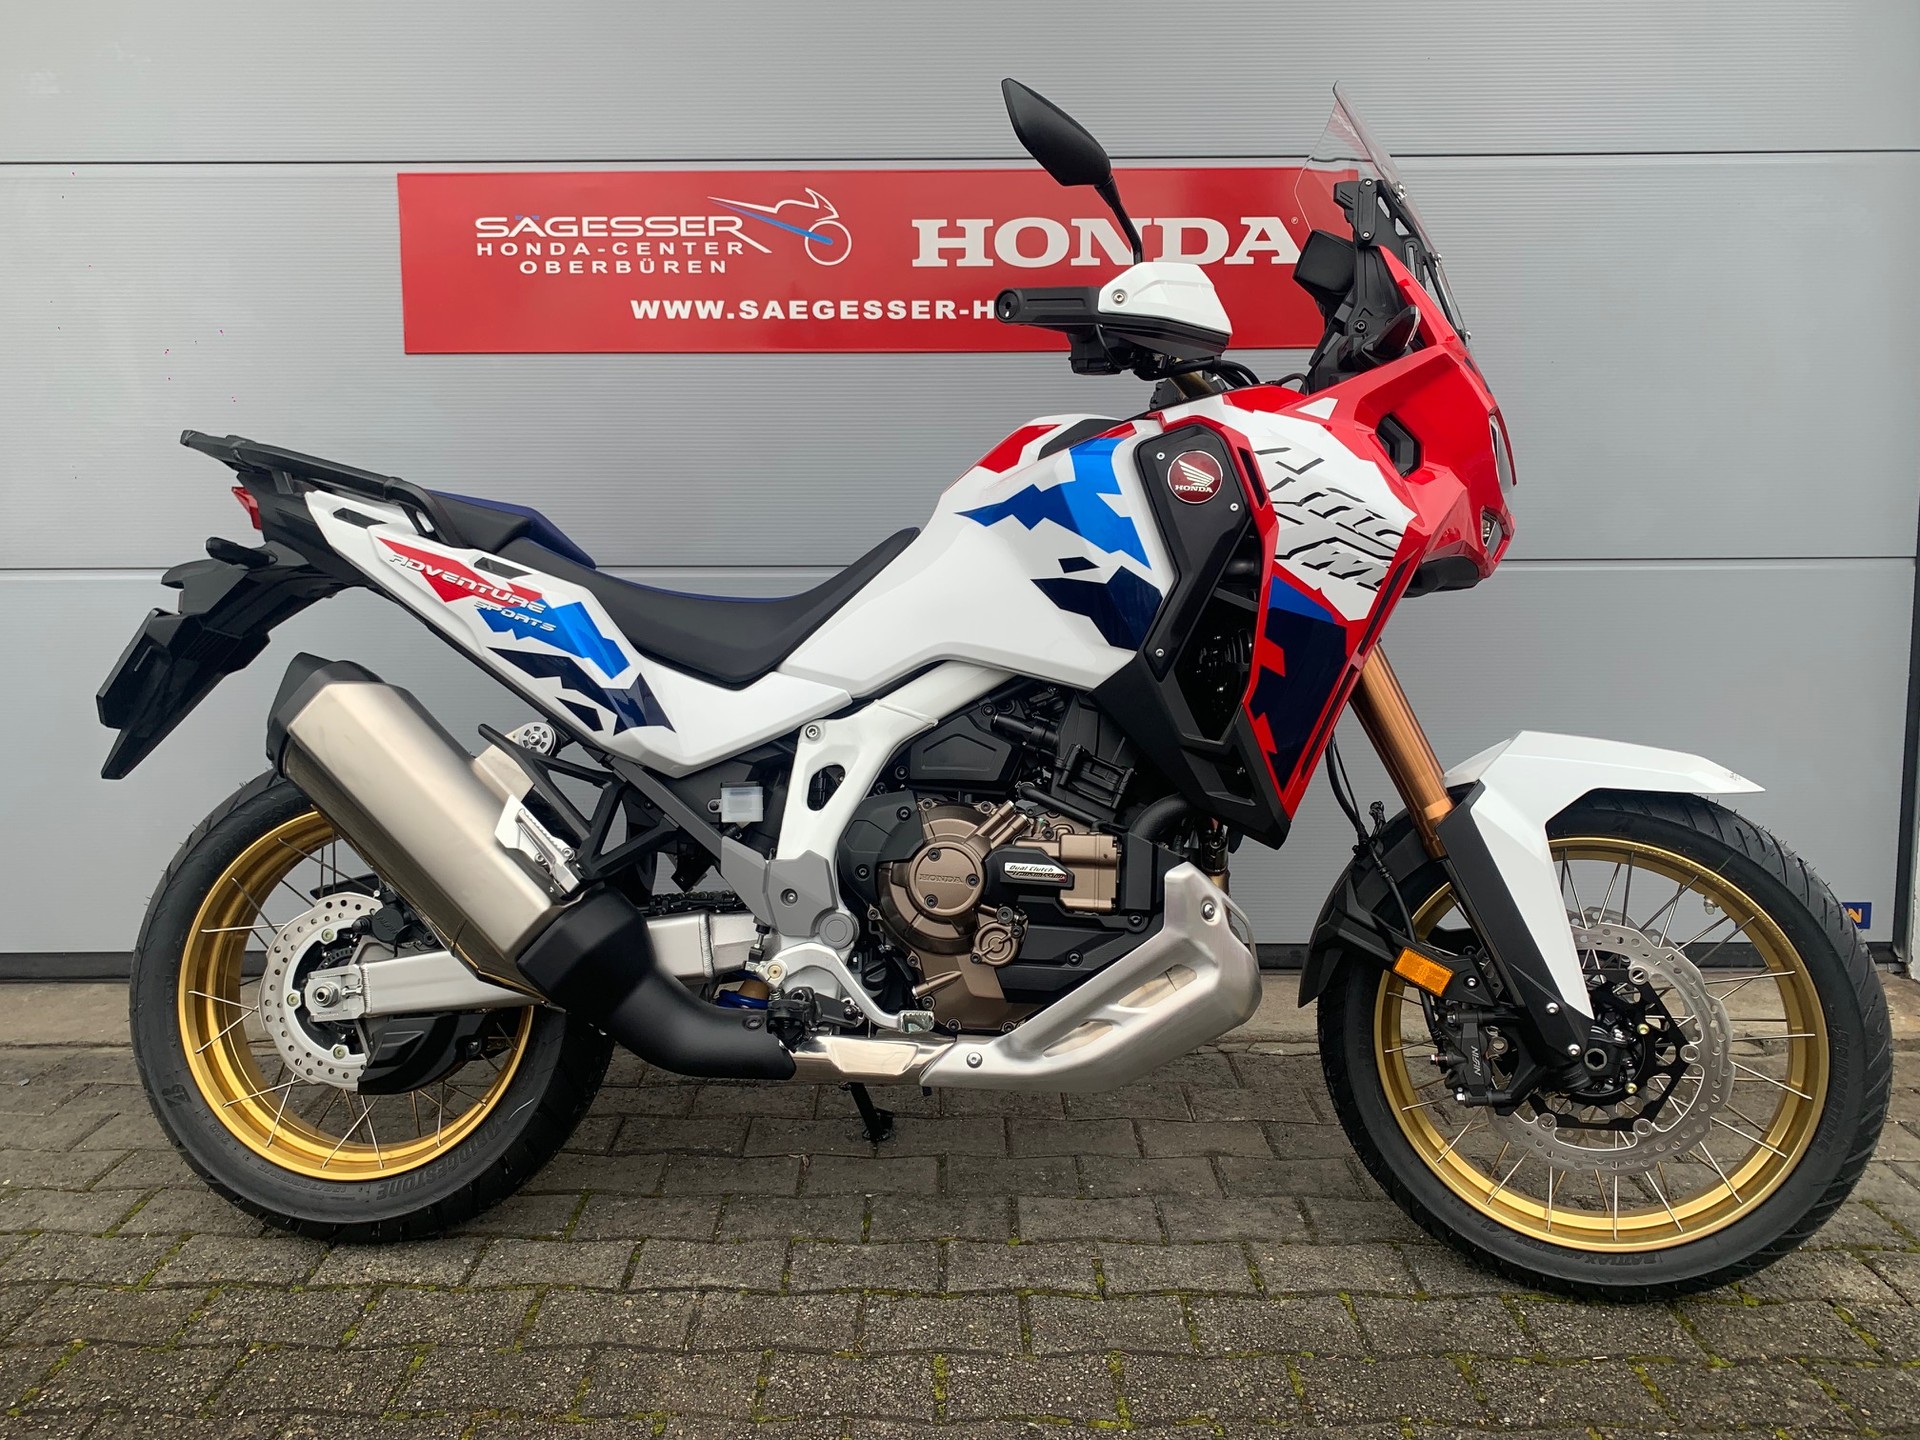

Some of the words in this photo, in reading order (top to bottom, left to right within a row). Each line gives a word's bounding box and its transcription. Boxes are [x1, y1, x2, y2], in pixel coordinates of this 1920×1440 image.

[475, 215, 768, 248] SÄGESSER
[911, 216, 1301, 267] HONDA
[476, 242, 744, 256] HONDA-CENTER
[519, 258, 726, 274] OBERBÜREN
[1175, 484, 1213, 493] HONDA
[389, 553, 547, 614] ADVENTURE
[473, 600, 556, 632] SPORTS
[919, 873, 964, 884] HONDA
[1470, 1045, 1482, 1077] NISSIN
